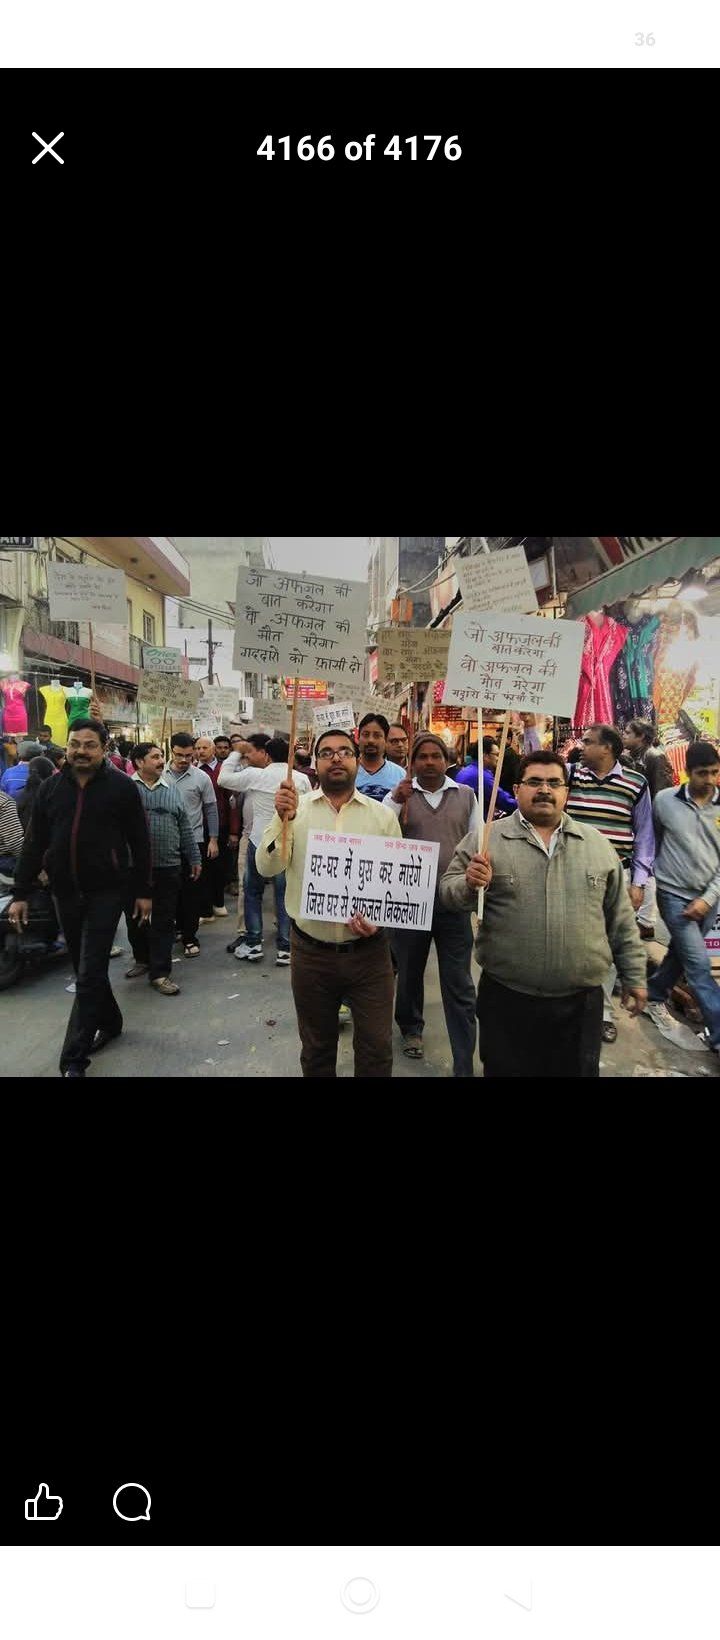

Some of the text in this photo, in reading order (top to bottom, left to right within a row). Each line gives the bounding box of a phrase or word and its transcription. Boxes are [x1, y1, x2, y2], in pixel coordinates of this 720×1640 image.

[246, 569, 267, 587] जो
[334, 583, 352, 598] की
[295, 595, 334, 614] करेगा
[301, 632, 338, 649] मरेगा
[464, 621, 488, 643] जो
[289, 648, 308, 665] को
[311, 855, 339, 878] घर-घर
[344, 847, 353, 879] में
[358, 860, 374, 891] घुस
[380, 861, 393, 884] कर
[306, 882, 325, 916] जिस
[327, 894, 339, 917] घर
[341, 885, 349, 917] से
